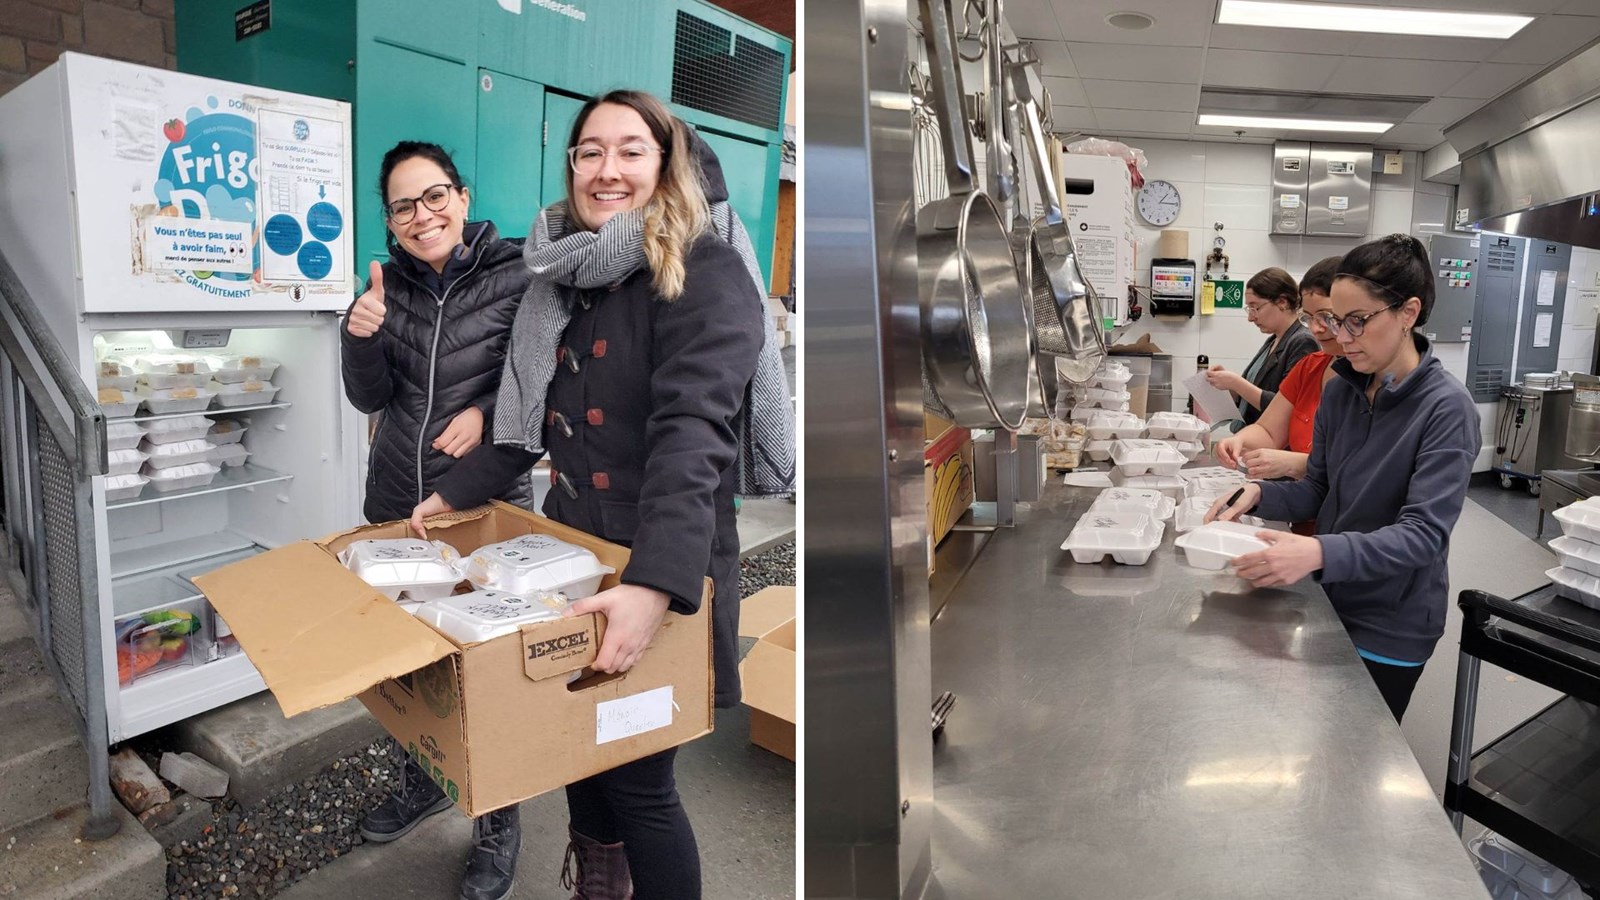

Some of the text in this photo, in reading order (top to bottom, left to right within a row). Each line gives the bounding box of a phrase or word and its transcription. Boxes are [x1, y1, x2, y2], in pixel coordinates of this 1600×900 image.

[154, 226, 242, 241] Vous n'êtes pas seul
[172, 241, 226, 255] à avoir faim,
[186, 275, 251, 298] GRATUITEMENT
[527, 631, 589, 660] EXCEL
